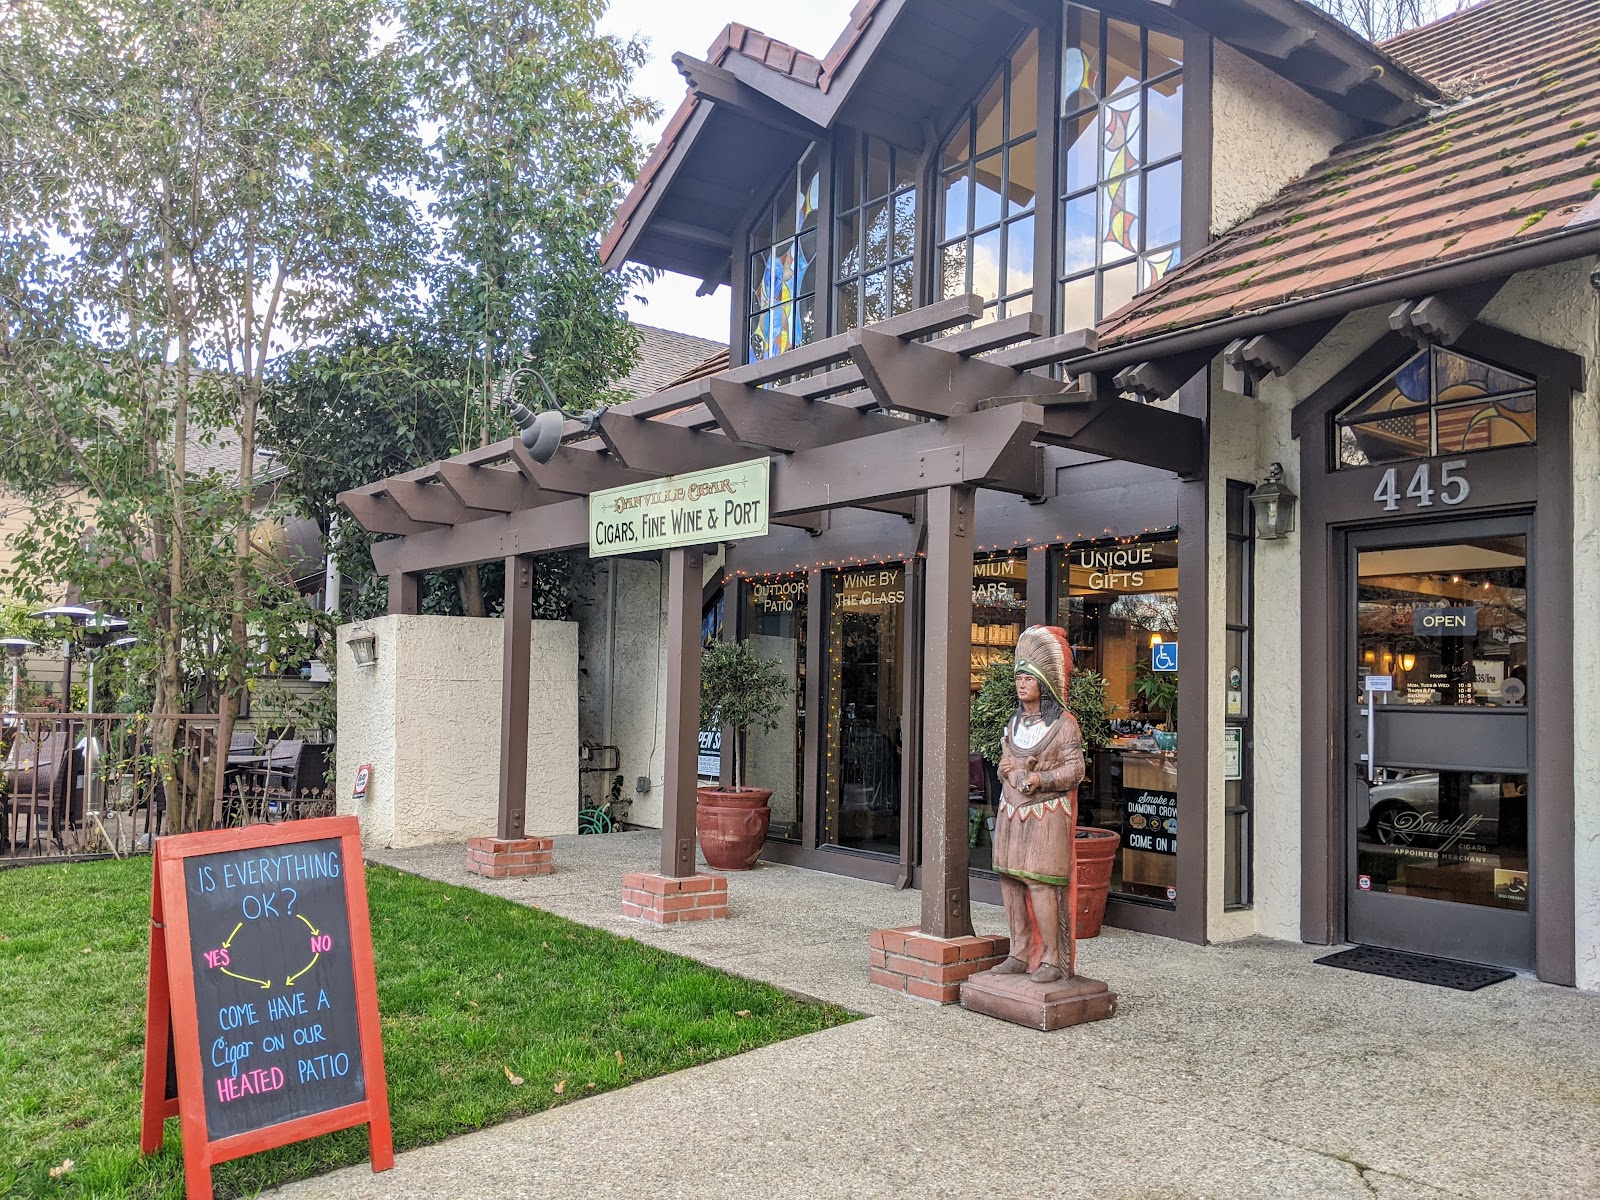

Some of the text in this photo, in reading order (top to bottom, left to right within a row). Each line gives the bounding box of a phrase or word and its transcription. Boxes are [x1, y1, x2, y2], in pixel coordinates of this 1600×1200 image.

[1373, 459, 1471, 511] 445
[614, 478, 737, 514] DANVILLE CIGAR
[595, 500, 761, 545] CIGARS, FINE WINE & PORT
[1080, 548, 1153, 568] UNIQUE
[974, 561, 1014, 577] MIUM
[843, 571, 898, 588] WINE BY
[1089, 571, 1144, 589] GIFTS
[754, 582, 806, 597] OUTDOOR
[764, 599, 793, 612] PATIO
[835, 590, 905, 608] THE GLASS
[1423, 616, 1466, 627] OPEN
[699, 731, 714, 748] PEN
[1138, 792, 1168, 805] Smoke
[1128, 802, 1178, 817] DIAMOND CROW
[1394, 811, 1483, 852] Davidoff
[1130, 834, 1153, 849] COME
[1156, 838, 1168, 851] ON
[1458, 843, 1487, 852] CIGARS
[1394, 848, 1487, 864] APPOINTED MERCHANT
[199, 851, 340, 893] IS EVERYTHING
[242, 887, 297, 920] OK?
[310, 935, 332, 953] NO
[203, 949, 230, 969] YES
[219, 988, 330, 1031] COME HAVE A
[211, 1024, 327, 1078] Cigar ON OUR
[216, 1052, 349, 1103] HEATED PATIO
